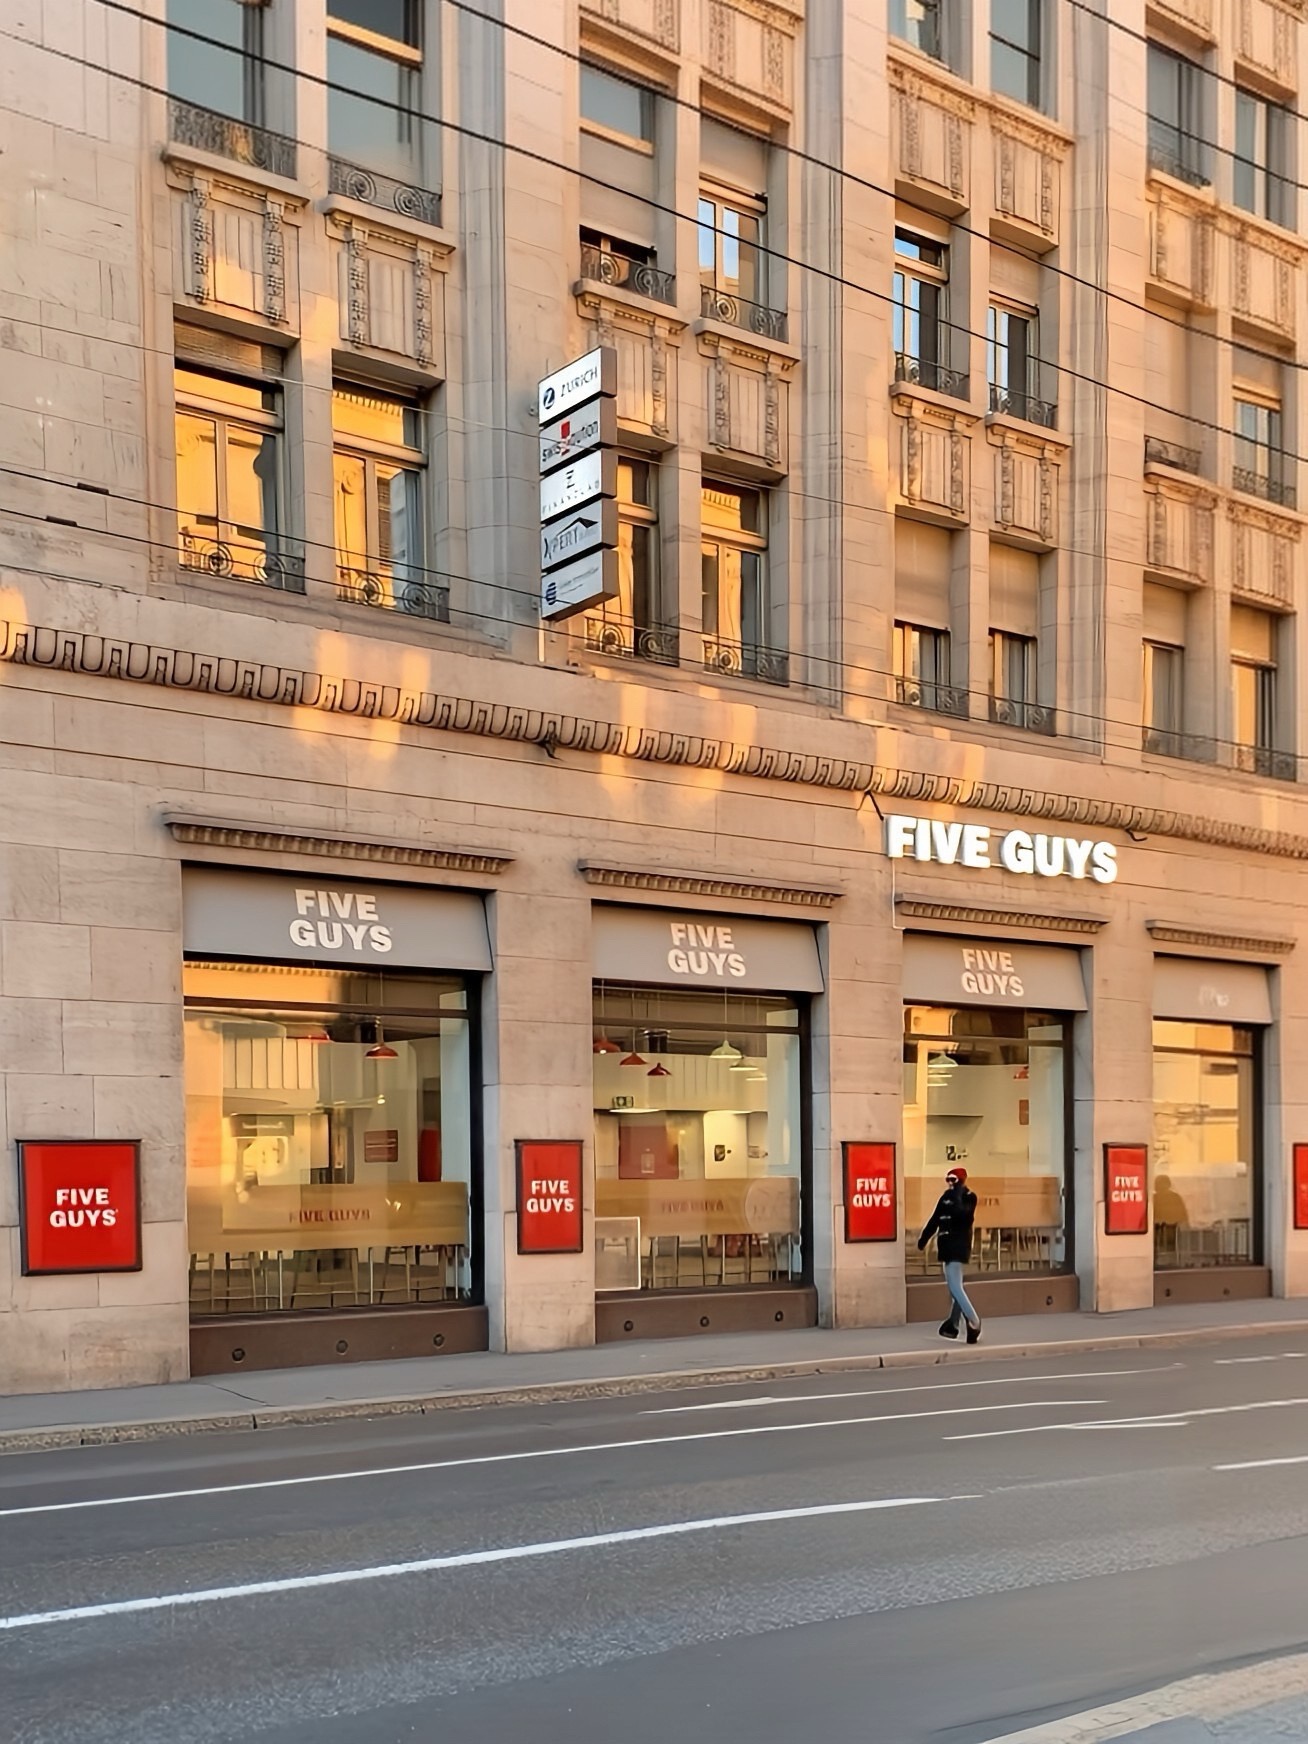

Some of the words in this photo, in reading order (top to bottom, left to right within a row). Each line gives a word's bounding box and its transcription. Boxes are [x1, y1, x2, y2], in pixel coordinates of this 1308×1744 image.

[561, 366, 597, 397] ZURICH
[886, 815, 992, 868] FIVE
[1001, 829, 1118, 884] GUYS
[295, 889, 379, 921] FIVE
[289, 919, 392, 953] GUYS
[670, 923, 735, 950] FIVE
[667, 948, 746, 977] GUYS
[962, 949, 1015, 972] FIVE
[961, 971, 1024, 997] GUYS
[531, 1179, 570, 1195] FIVE
[856, 1177, 887, 1192] FIVE
[56, 1188, 110, 1206] FIVE
[526, 1197, 575, 1213] GUYS
[852, 1193, 892, 1208] GUYS
[49, 1209, 117, 1228] GUYS
